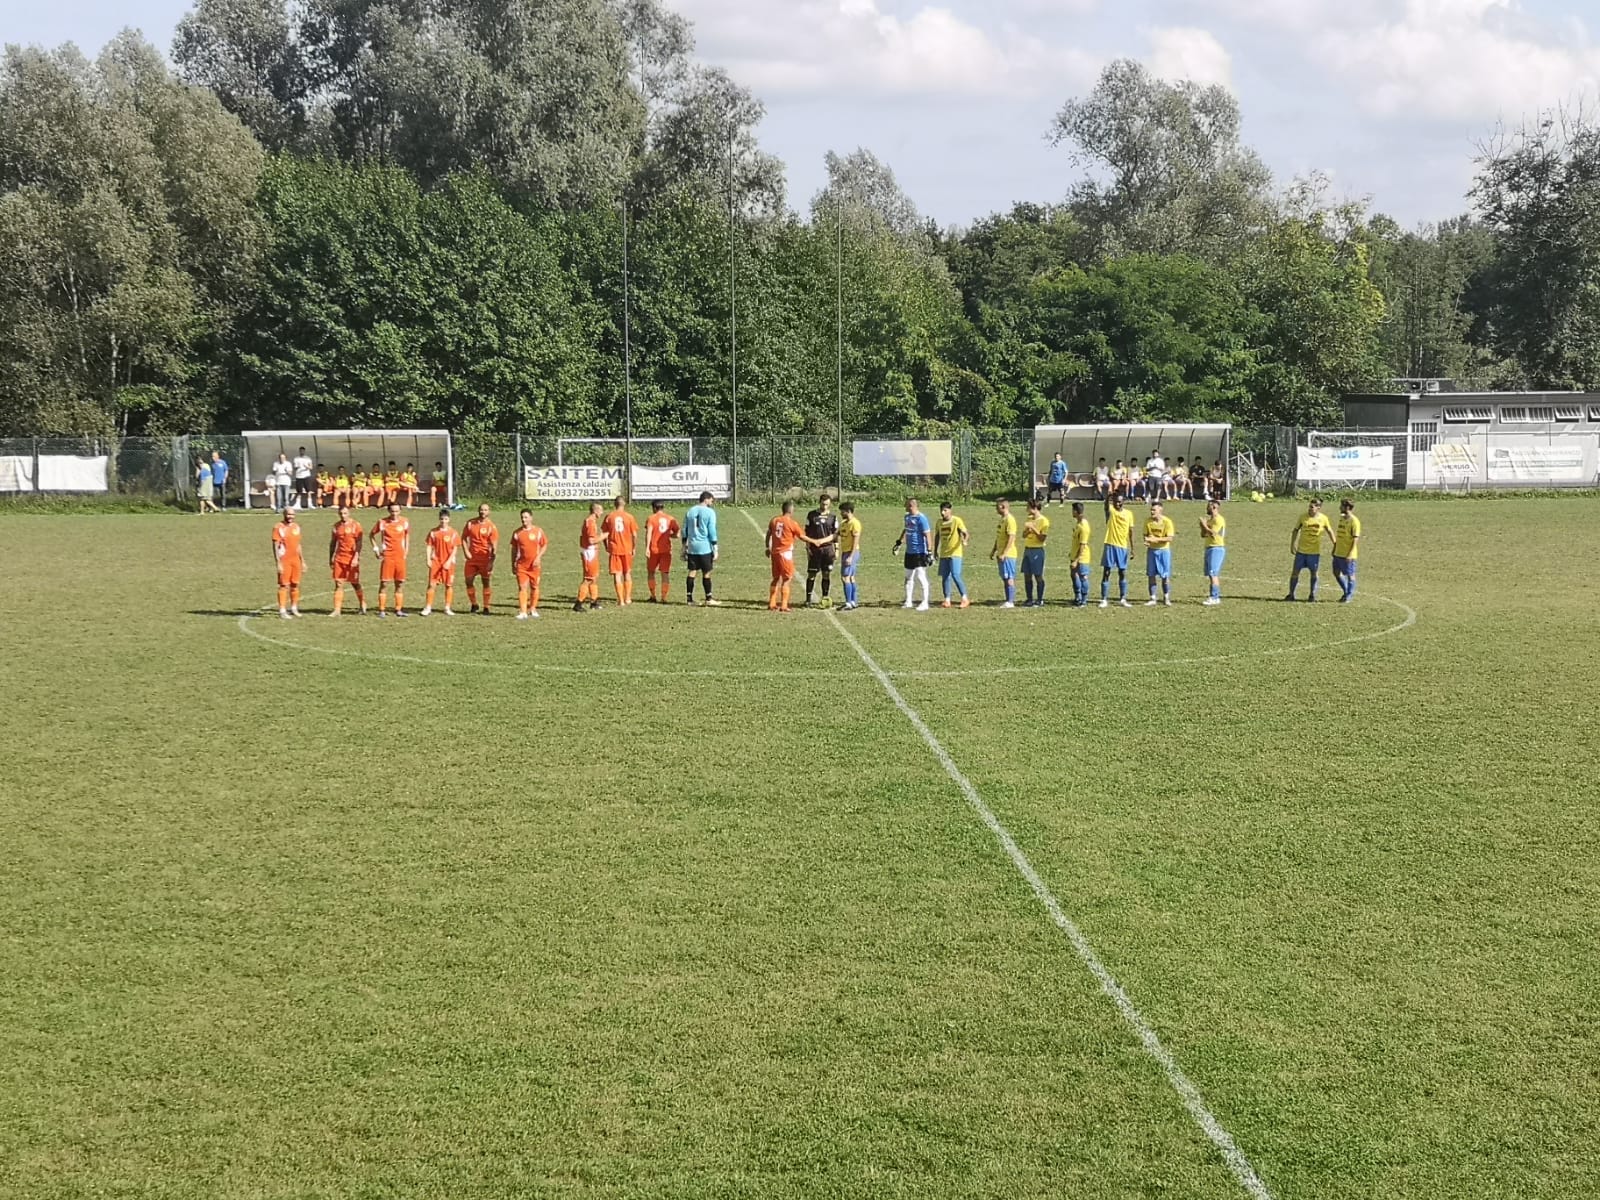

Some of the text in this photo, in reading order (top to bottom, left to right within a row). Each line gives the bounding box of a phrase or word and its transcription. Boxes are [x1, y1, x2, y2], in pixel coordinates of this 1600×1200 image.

[527, 467, 623, 480] SAITEM
[672, 471, 699, 481] GM
[537, 480, 613, 488] Assistenza caldaie
[536, 489, 611, 497] Tel. 0332782551
[775, 521, 784, 538] 5
